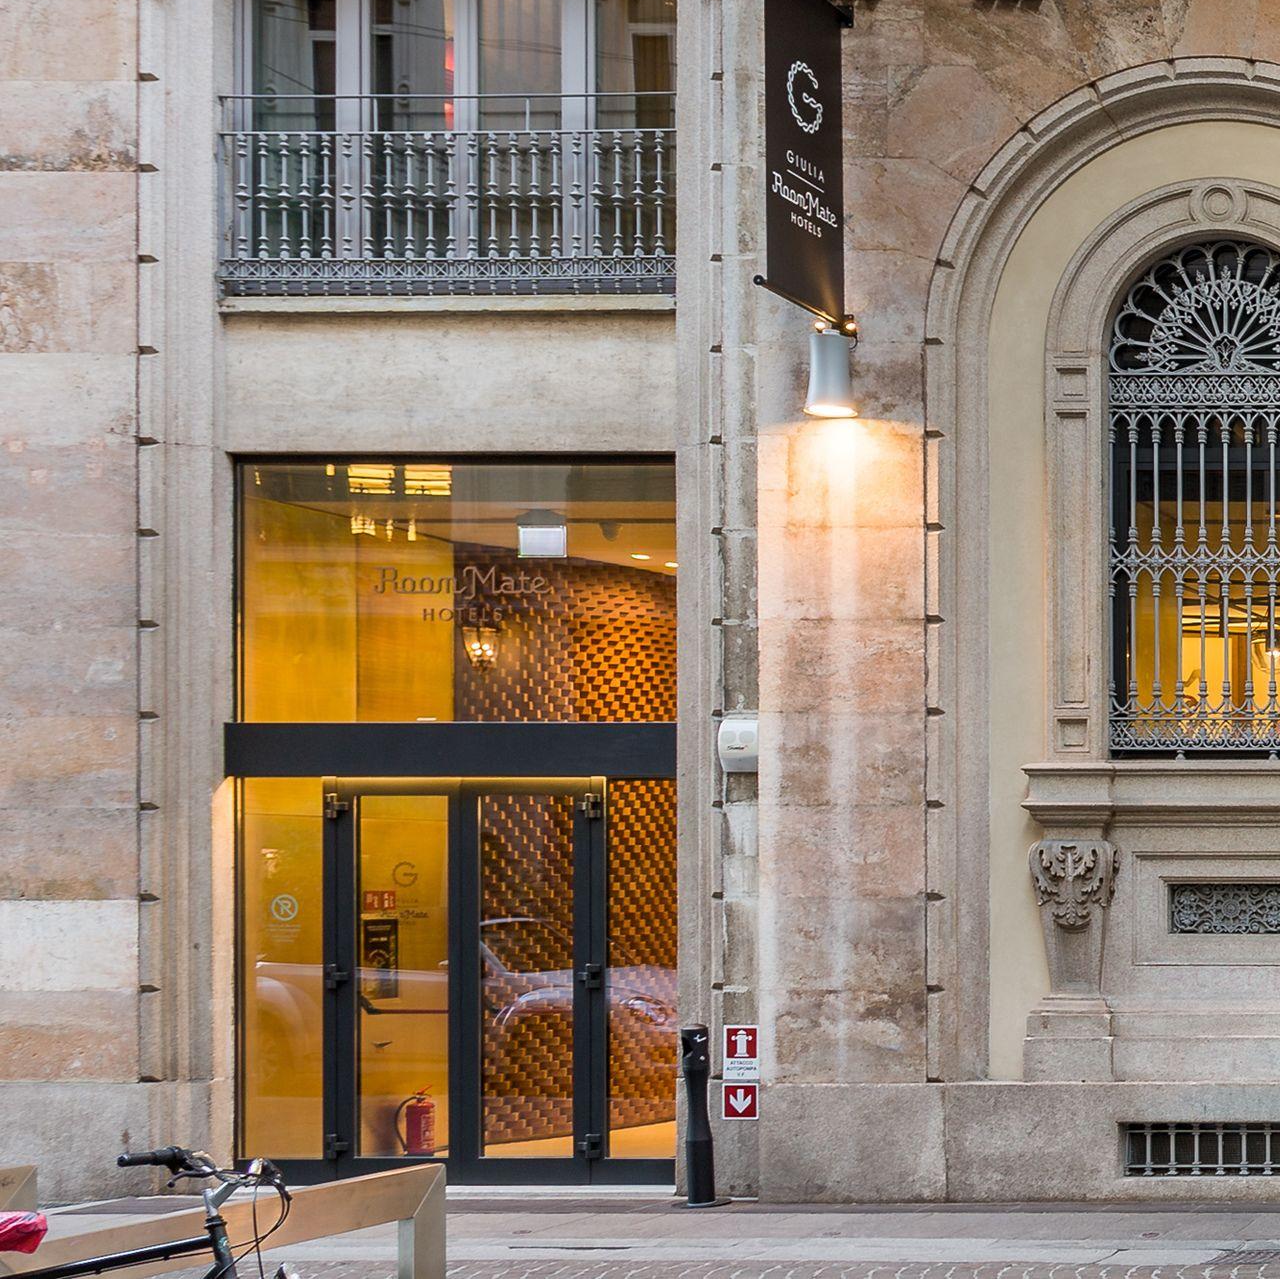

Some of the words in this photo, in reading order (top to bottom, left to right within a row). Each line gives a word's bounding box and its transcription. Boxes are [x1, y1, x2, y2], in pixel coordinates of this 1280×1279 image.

[786, 150, 825, 183] GIULIA
[790, 212, 822, 238] HOTELS
[423, 608, 503, 622] HOTELS
